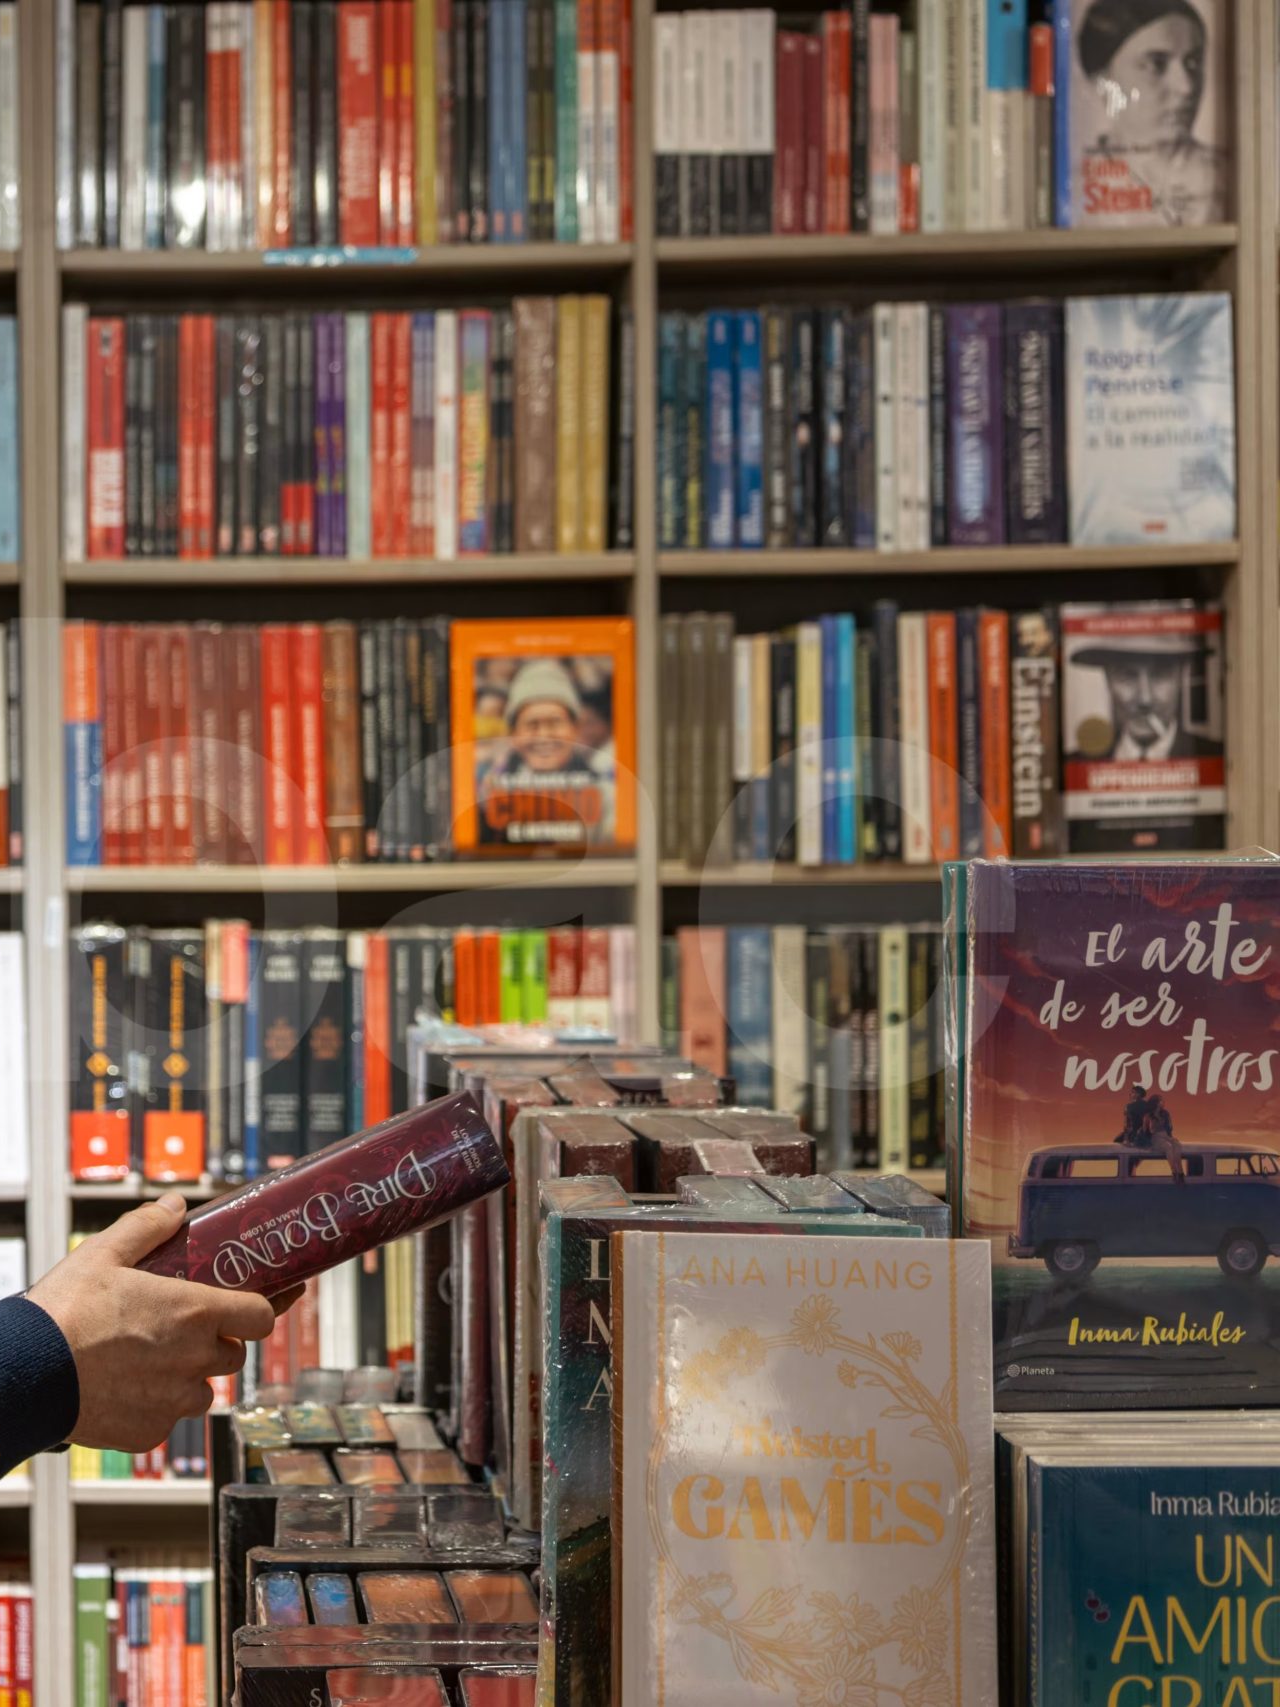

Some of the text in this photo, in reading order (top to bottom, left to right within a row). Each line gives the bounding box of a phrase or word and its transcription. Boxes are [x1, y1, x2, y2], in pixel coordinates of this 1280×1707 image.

[1086, 376, 1184, 396] Penrose
[1012, 656, 1056, 817] Einstein
[1085, 903, 1272, 980] El arte
[1039, 979, 1183, 1030] de ser
[1062, 1018, 1279, 1096] nosotros
[214, 1151, 437, 1287] DIRE BOUND
[238, 1206, 302, 1242] ALMA DE LOBO
[680, 1254, 934, 1291] ANA HUANG
[1067, 1311, 1246, 1347] Inma Rubiales
[1021, 1364, 1055, 1377] Planeta
[732, 1417, 891, 1477] Twisted
[671, 1473, 946, 1547] GAMES
[1150, 1490, 1213, 1517] Inma
[1195, 1534, 1273, 1588] UN
